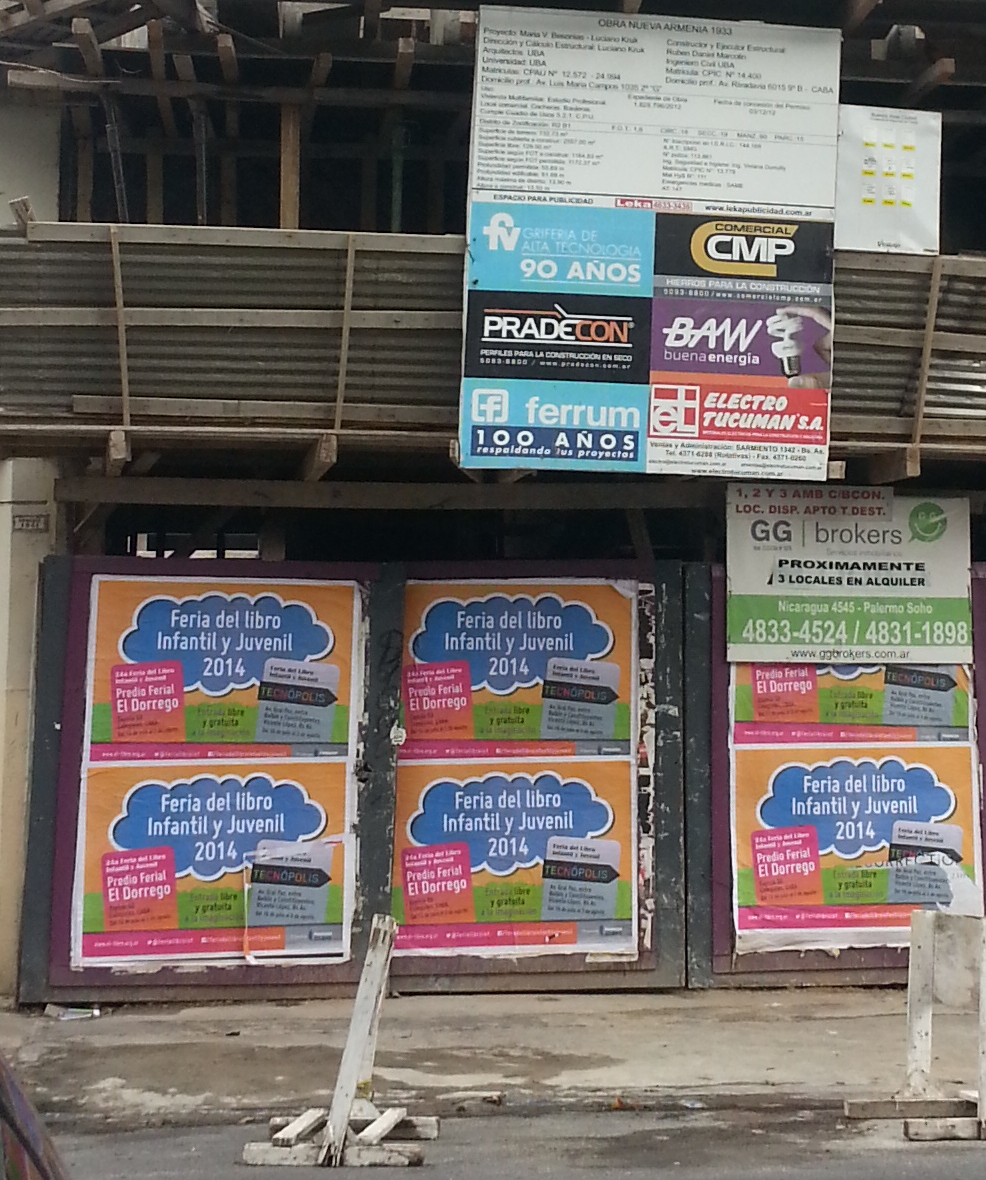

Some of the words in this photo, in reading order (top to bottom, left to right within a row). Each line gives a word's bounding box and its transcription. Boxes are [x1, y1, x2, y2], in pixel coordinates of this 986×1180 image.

[599, 19, 626, 28] OBRA
[629, 20, 662, 29] NUEVA
[664, 23, 708, 34] ARMENIA
[711, 25, 732, 36] 1933
[616, 199, 652, 208] Leka
[582, 230, 597, 242] DE
[715, 223, 791, 235] COMERCIAL
[522, 242, 549, 252] ALTA
[707, 235, 795, 262] CMP
[520, 259, 557, 279] 90
[567, 260, 641, 282] AÑOS
[666, 278, 706, 288] HIERROS
[709, 280, 733, 290] PARA
[735, 281, 747, 290] LA
[750, 281, 820, 293] CONSTRUCCIÓN
[663, 317, 762, 352] BAW
[546, 352, 600, 360] CONSTRUCCIÓN
[704, 393, 788, 411] ELECTRO
[526, 396, 640, 428] ferrum
[703, 412, 796, 430] TUCUMAN
[798, 416, 823, 431] S.A.
[477, 429, 533, 446] 100
[555, 431, 635, 450] AÑOS
[736, 444, 777, 452] SARMIENTO
[477, 446, 550, 455] respaldando
[556, 448, 572, 456] tus
[578, 449, 634, 459] proyectos
[736, 489, 748, 499] 1,
[753, 488, 761, 498] 2
[767, 489, 774, 498] Y
[780, 489, 787, 498] 3
[792, 489, 823, 499] AMB
[828, 490, 885, 500] C/BCON.
[736, 504, 764, 514] LOC.
[769, 505, 799, 515] DISP.
[804, 506, 836, 515] APTO
[750, 520, 792, 542] GG
[815, 522, 902, 544] brokers
[778, 559, 926, 571] PROXIMAMENTE
[789, 576, 842, 585] LOCALES
[847, 577, 863, 586] EN
[867, 577, 926, 587] ALQUILER
[778, 601, 829, 616] Nicaragua
[831, 601, 855, 613] 4545
[863, 601, 904, 615] Palermo
[906, 602, 933, 615] Soho
[171, 610, 210, 628] Feria
[216, 609, 240, 628] del
[245, 611, 281, 629] libro
[457, 611, 494, 628] Feria
[500, 611, 523, 629] del
[528, 611, 562, 628] libro
[742, 618, 848, 644] 4833-4524
[865, 621, 968, 644] 4831-1898
[157, 632, 217, 651] Infantil
[221, 636, 231, 655] y
[236, 633, 292, 652] Juvenil
[445, 634, 501, 651] Infantil
[505, 638, 514, 655] y
[519, 633, 574, 651] Juvenil
[791, 648, 910, 660] www.ggbrokers.com.ar
[203, 657, 245, 677] 2014
[489, 657, 529, 676] 2014
[116, 685, 147, 698] Predio
[149, 683, 175, 696] Ferial
[117, 698, 128, 713] El
[131, 696, 179, 712] Dorrego
[803, 775, 839, 793] Feria
[845, 775, 867, 793] del
[872, 775, 905, 792] libro
[161, 794, 200, 813] Feria
[207, 794, 231, 812] del
[236, 793, 272, 811] libro
[455, 791, 493, 809] Feria
[498, 791, 521, 809] del
[527, 789, 561, 808] libro
[792, 798, 847, 816] Infantil
[852, 801, 860, 819] y
[865, 796, 917, 814] Juvenil
[148, 817, 208, 836] Infantil
[213, 820, 222, 839] y
[228, 814, 284, 834] Juvenil
[443, 813, 500, 832] Infantil
[505, 818, 514, 835] y
[519, 810, 573, 830] Juvenil
[836, 821, 875, 840] 2014
[195, 842, 236, 861] 2014
[488, 837, 528, 857] 2014
[759, 864, 769, 878] El
[772, 861, 815, 876] Dorrego
[108, 887, 119, 903] El
[122, 885, 171, 901] Dorrego
